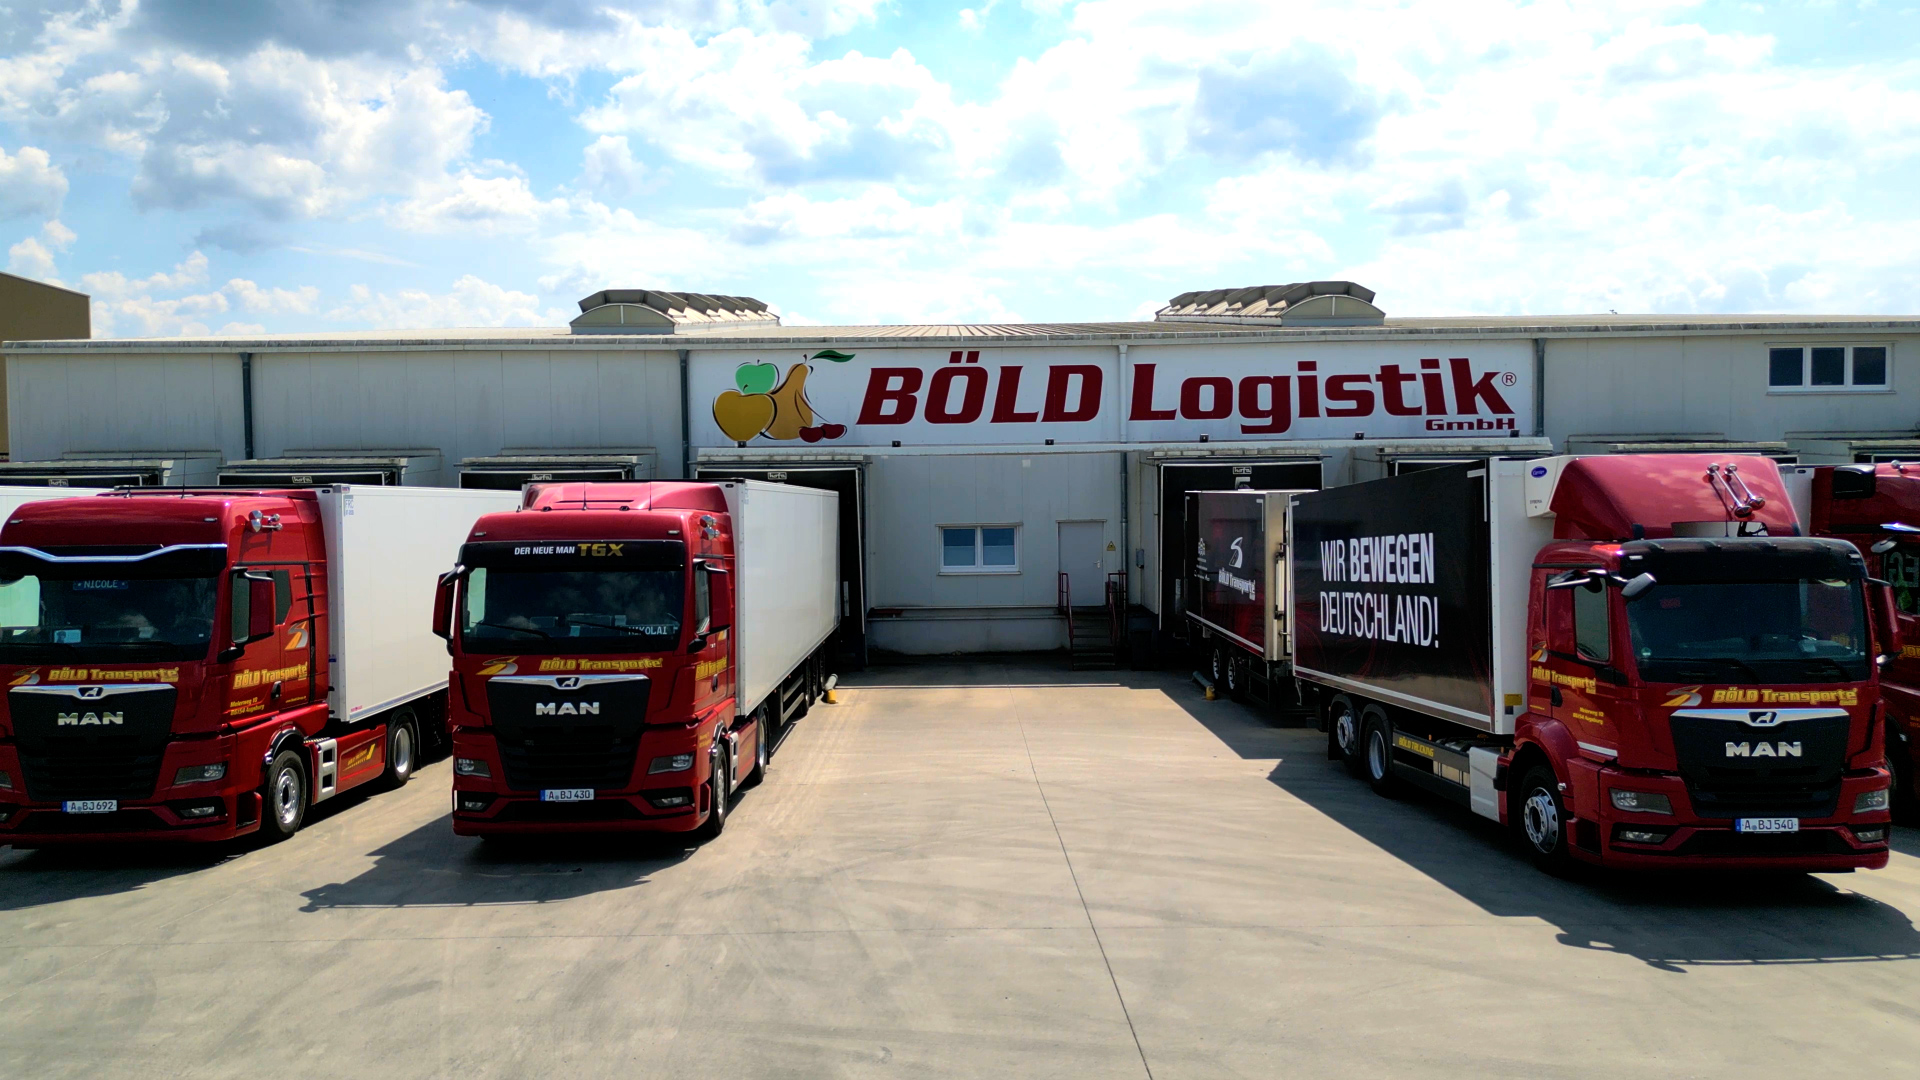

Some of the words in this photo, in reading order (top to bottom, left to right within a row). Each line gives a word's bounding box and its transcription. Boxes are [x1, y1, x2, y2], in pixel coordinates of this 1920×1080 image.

[856, 351, 1103, 424] BÖLD
[1425, 418, 1515, 430] GmbH
[514, 547, 530, 555] DER
[532, 546, 554, 555] NEUE
[556, 546, 575, 554] MAN
[577, 543, 624, 556] TGX
[1320, 540, 1346, 581] WIR
[1349, 533, 1434, 583] BEWEGEN
[84, 580, 118, 588] NICOLE
[1320, 591, 1439, 648] DEUTSCHLAND!
[539, 657, 577, 671] BÖLD
[47, 667, 89, 681] BÖLD
[232, 669, 260, 689] BÖLD
[1532, 666, 1550, 681] BÖLD
[1711, 687, 1759, 703] BÖLD
[535, 702, 600, 715] MAN
[57, 711, 123, 726] MAN
[1725, 741, 1802, 757] MAN
[574, 790, 590, 799] 430
[1774, 819, 1794, 830] 540
